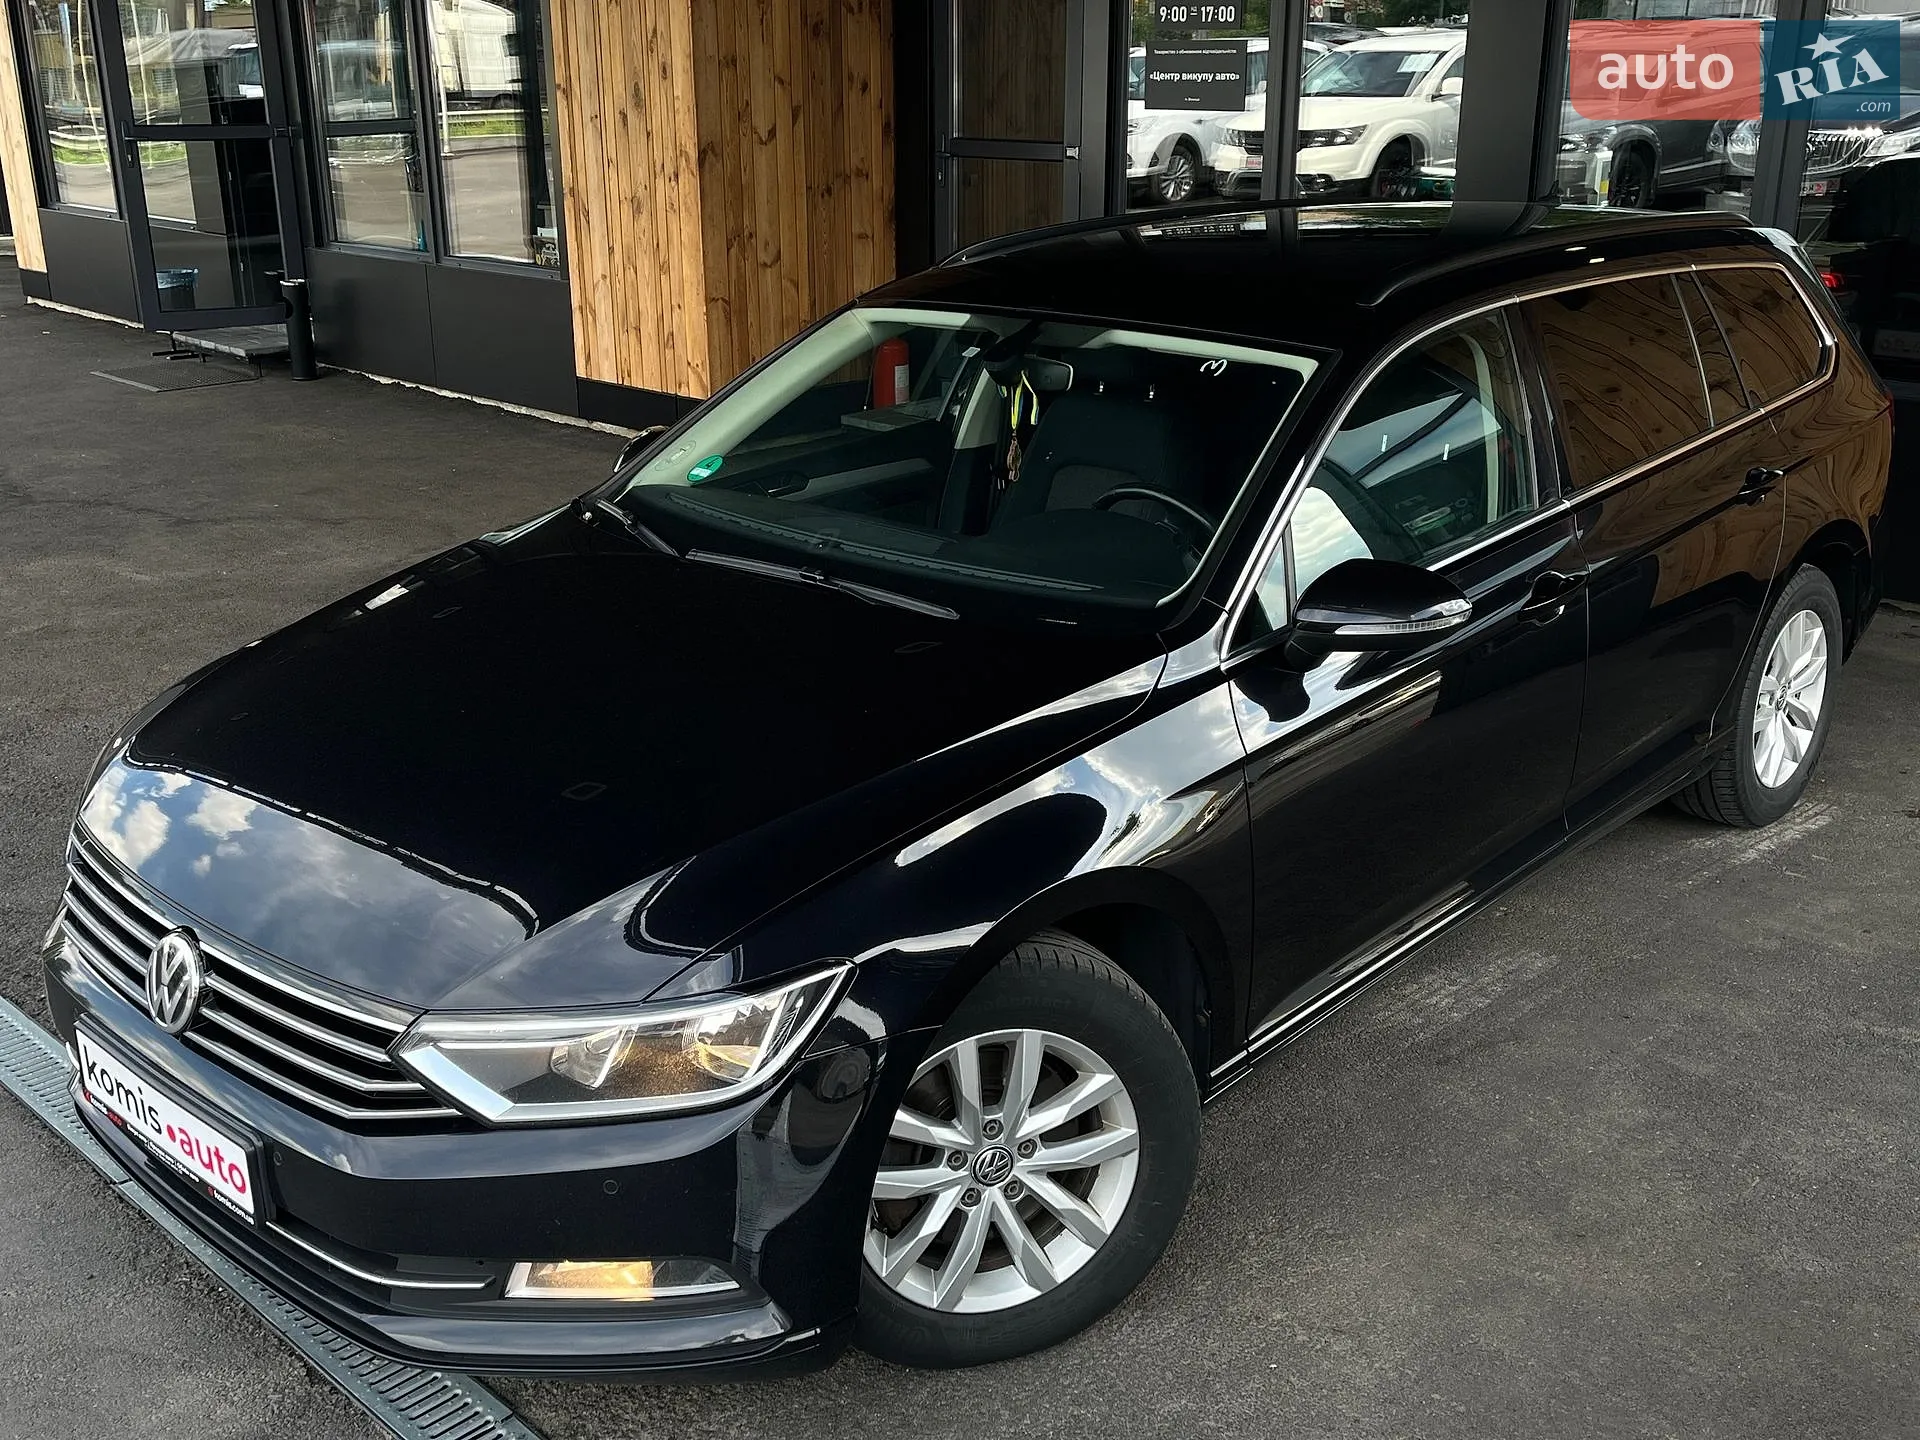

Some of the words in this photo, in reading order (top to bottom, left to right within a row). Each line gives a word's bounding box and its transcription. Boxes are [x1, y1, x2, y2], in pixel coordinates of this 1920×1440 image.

[1159, 5, 1187, 23] 9:00
[1200, 5, 1235, 23] 17:00
[1149, 71, 1180, 82] «Центр
[1181, 72, 1214, 83] викупу
[1215, 72, 1240, 81] авто»
[83, 1044, 163, 1135] komis
[178, 1126, 247, 1194] auto
